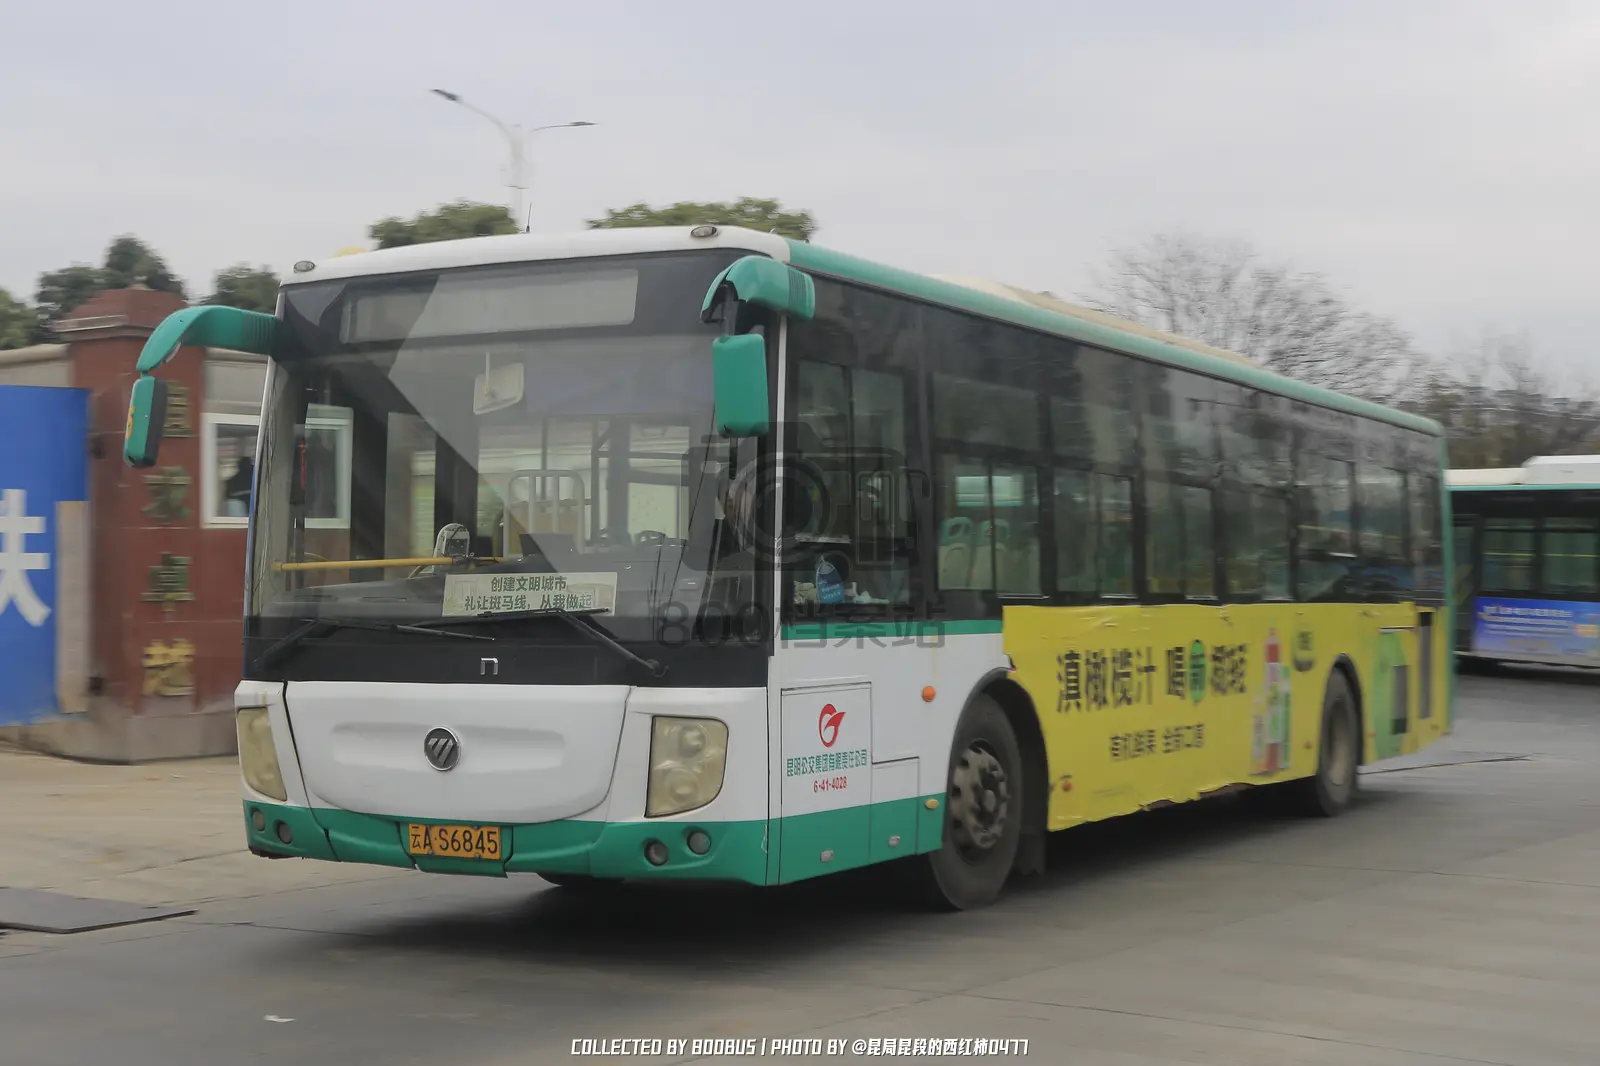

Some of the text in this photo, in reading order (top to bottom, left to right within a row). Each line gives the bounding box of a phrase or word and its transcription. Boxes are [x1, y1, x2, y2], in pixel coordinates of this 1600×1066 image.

[490, 575, 568, 593] 创建文明城市
[786, 749, 868, 777] 昆明公交集团有限责任公司
[813, 776, 848, 793] 6-41-4028
